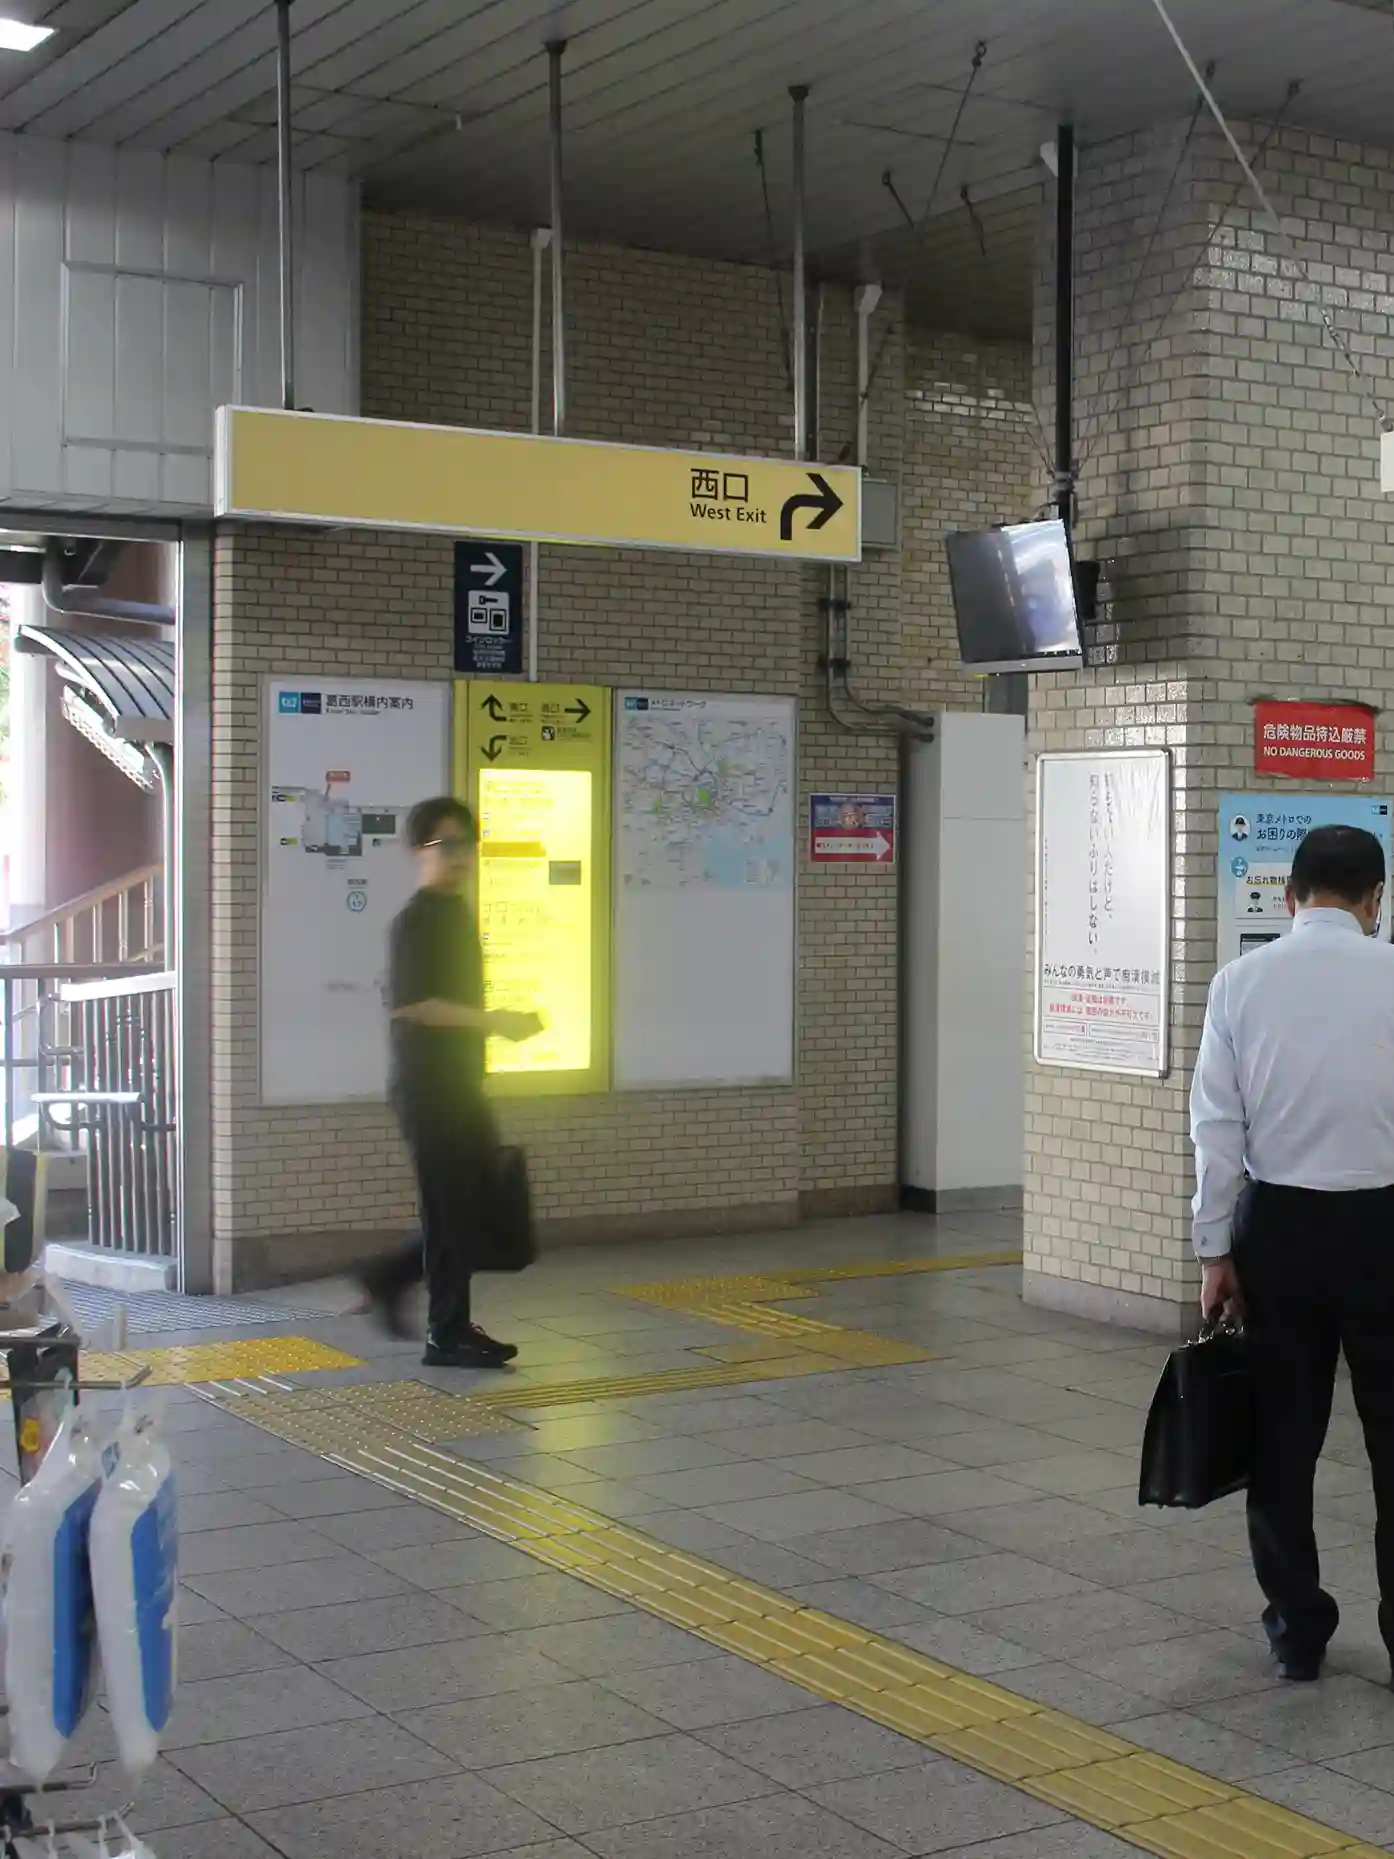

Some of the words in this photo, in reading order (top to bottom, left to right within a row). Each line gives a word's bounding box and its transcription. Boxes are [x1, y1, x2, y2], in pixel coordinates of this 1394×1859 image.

[690, 468, 749, 502] 西口
[690, 503, 731, 520] West
[736, 507, 767, 523] Exit
[1263, 723, 1367, 744] 危険物品持込厳禁
[1263, 746, 1278, 757] NO
[1279, 747, 1333, 759] DANGEROUS
[1334, 749, 1365, 761] GOODS
[1256, 813, 1312, 825] 東京メトロでの
